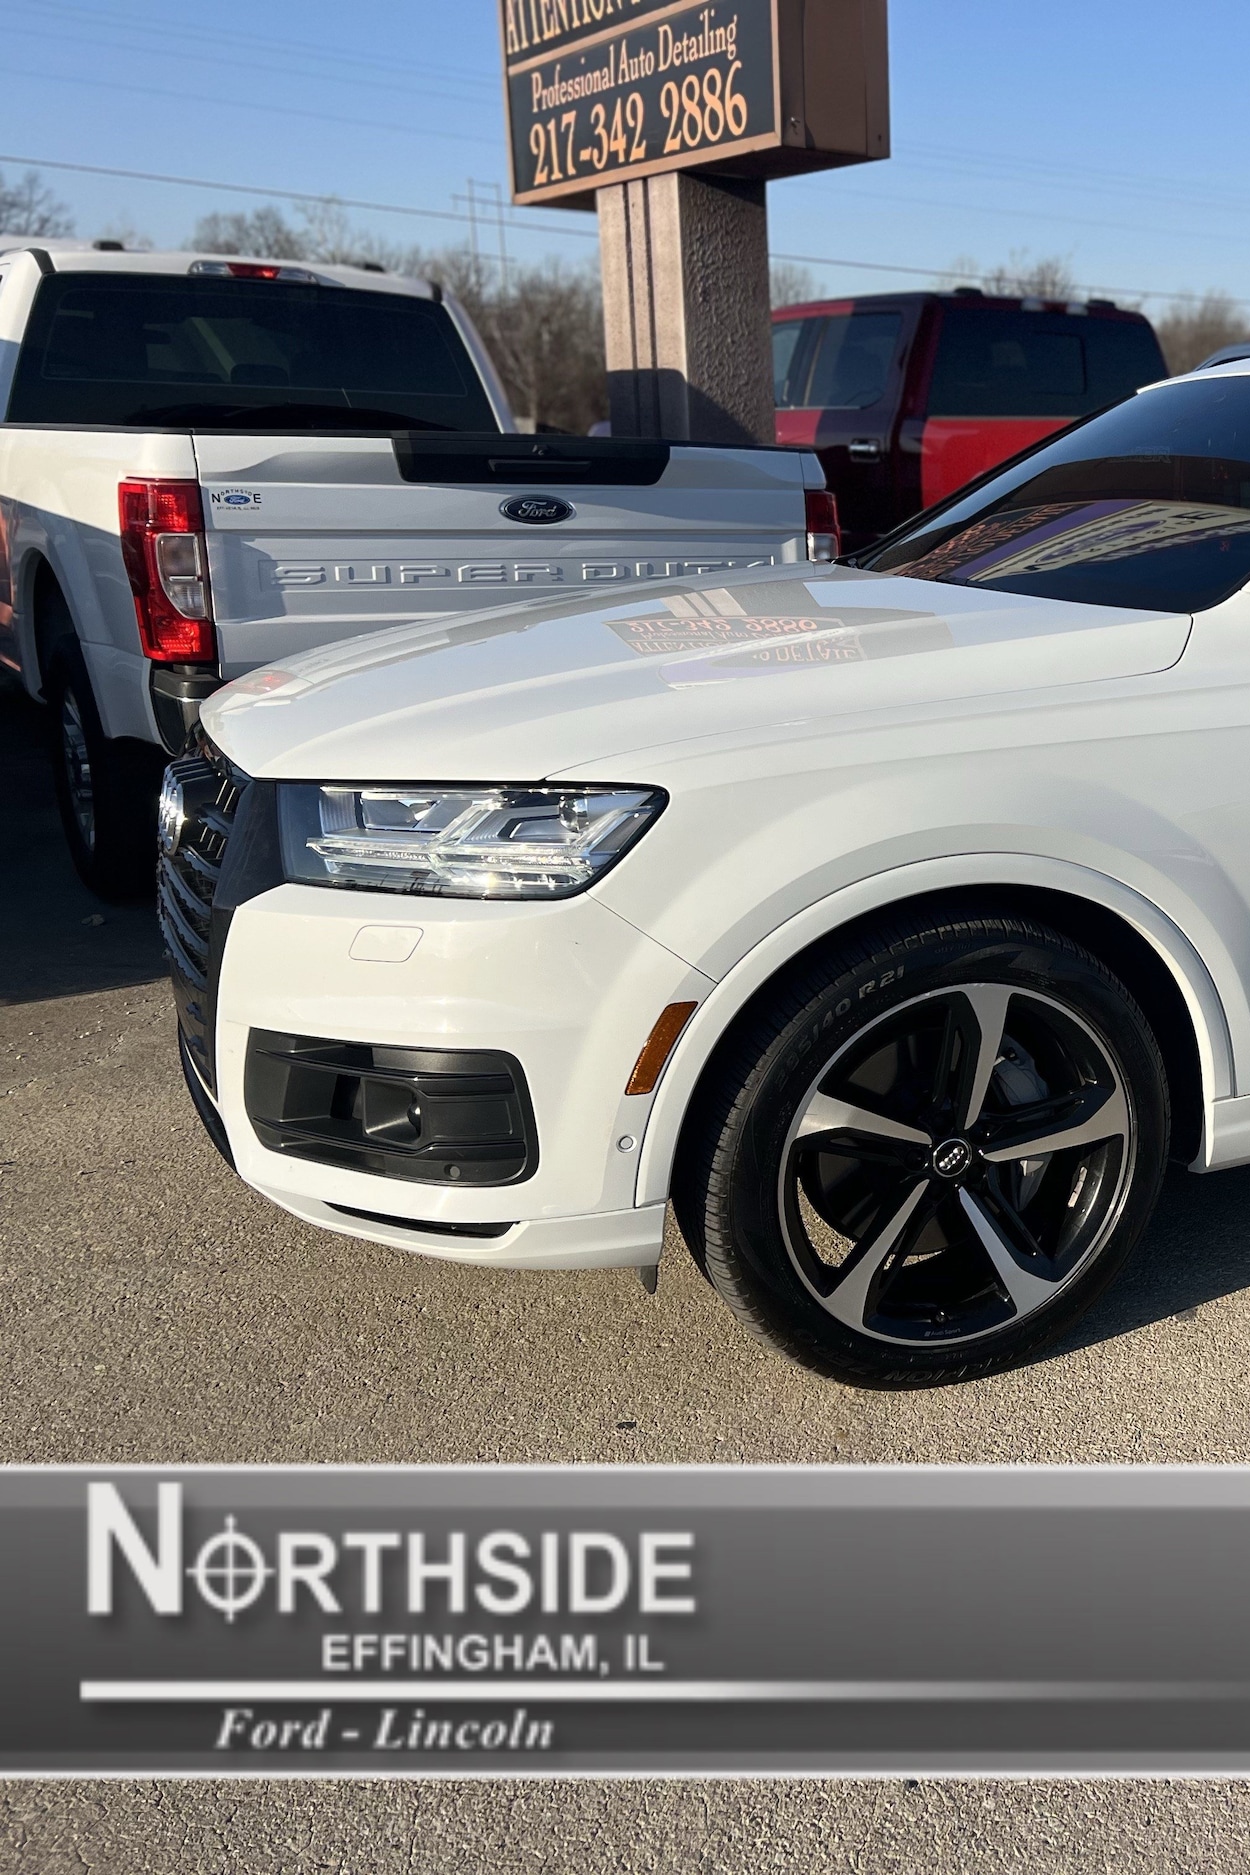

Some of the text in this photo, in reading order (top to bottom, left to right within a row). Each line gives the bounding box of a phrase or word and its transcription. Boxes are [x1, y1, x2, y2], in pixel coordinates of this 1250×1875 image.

[531, 9, 738, 113] Professional Auto Detailing
[529, 60, 748, 187] 217-342 2886
[519, 501, 557, 518] Ford
[272, 565, 563, 584] SUPER
